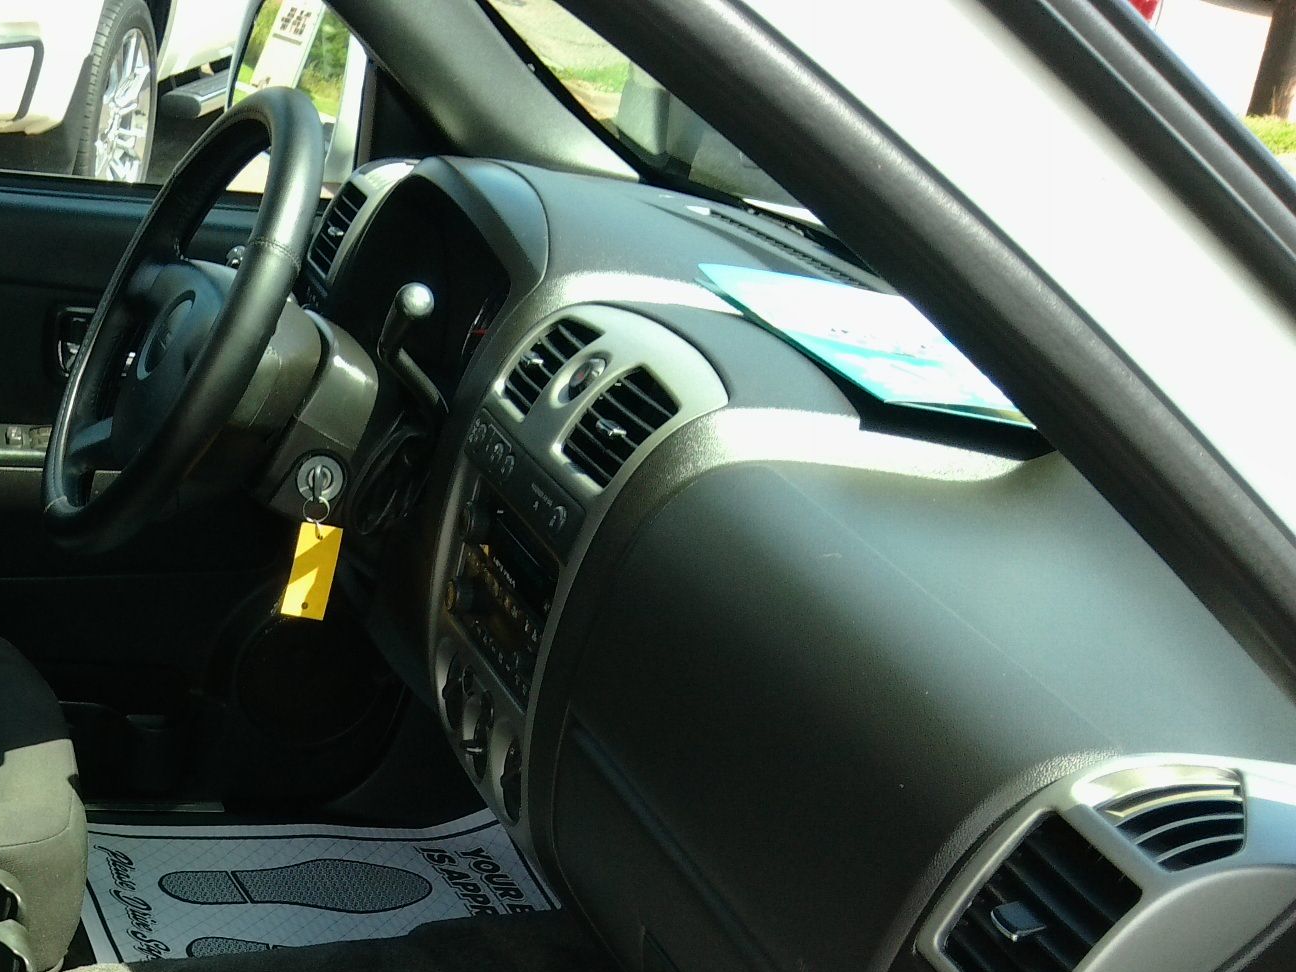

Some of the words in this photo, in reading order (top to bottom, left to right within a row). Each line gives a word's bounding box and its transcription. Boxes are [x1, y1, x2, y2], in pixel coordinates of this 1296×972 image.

[94, 845, 136, 891] Please
[417, 847, 456, 866] IS
[458, 847, 525, 901] YOUR
[110, 888, 157, 933] Drive
